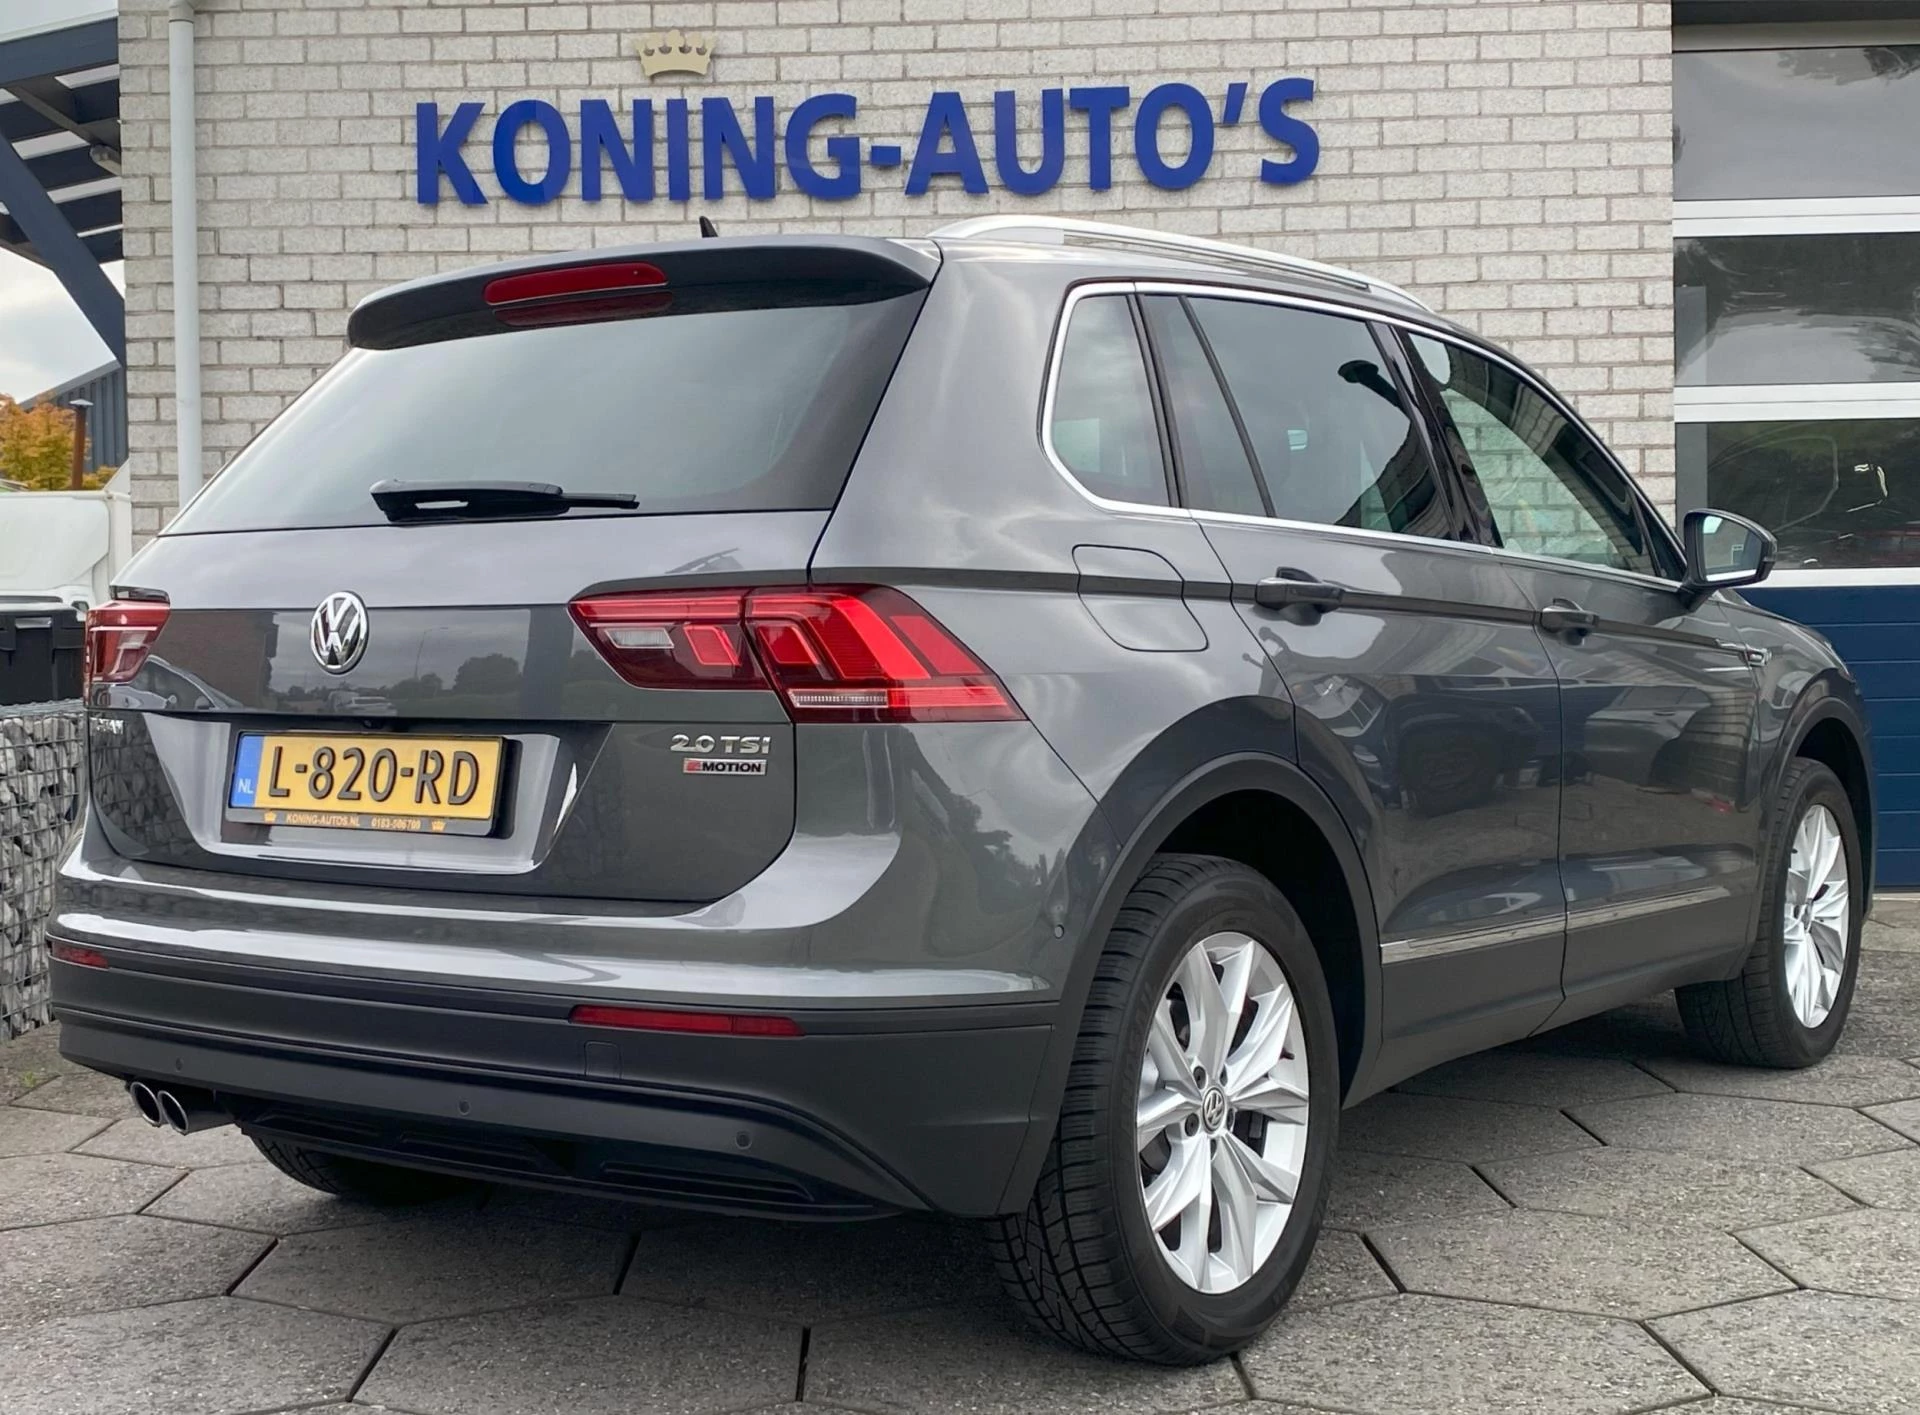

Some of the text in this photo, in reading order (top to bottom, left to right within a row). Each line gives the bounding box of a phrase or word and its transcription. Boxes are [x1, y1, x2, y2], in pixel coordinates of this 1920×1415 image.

[416, 77, 1320, 207] KONING-AUTO'S
[720, 736, 771, 754] TSI
[237, 746, 480, 806] NL L-820-RD
